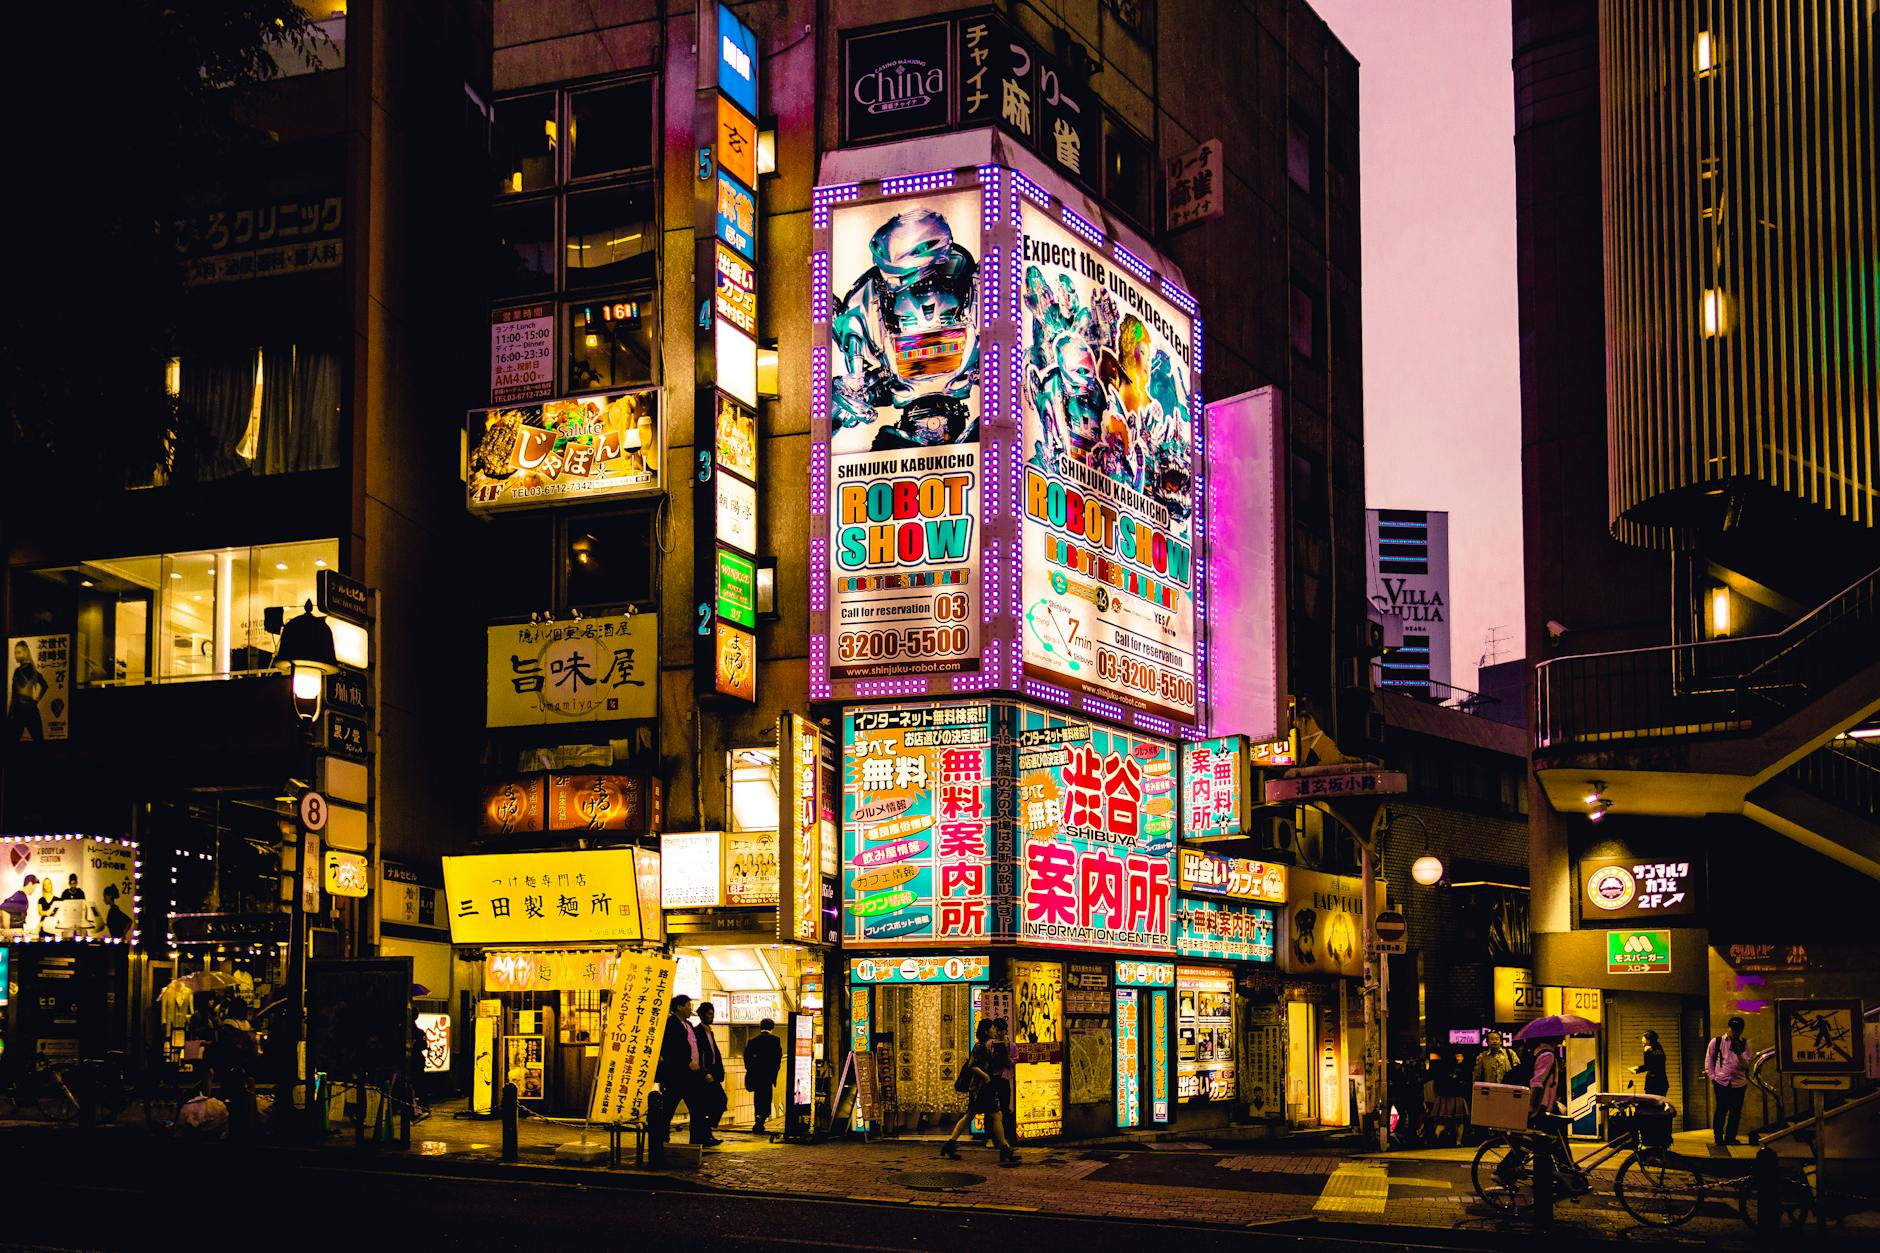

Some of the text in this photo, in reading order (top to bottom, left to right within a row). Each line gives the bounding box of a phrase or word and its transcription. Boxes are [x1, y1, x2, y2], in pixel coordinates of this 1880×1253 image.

[966, 24, 989, 114] チャイナ
[854, 65, 943, 105] China
[699, 148, 711, 180] 5
[725, 224, 746, 250] 5F
[718, 252, 753, 290] 出会い
[722, 277, 753, 312] カフェ
[1023, 235, 1190, 368] Expect the unexpected
[502, 307, 542, 321] 営業時間
[699, 299, 711, 330] 4
[496, 322, 536, 333] ランチ Lunch
[496, 328, 550, 345] 11:00-15:00
[496, 347, 550, 363] 16:00-23:30
[495, 371, 536, 386] AM4:00
[557, 422, 603, 438] Salute
[517, 430, 620, 479] じゃぽん
[699, 449, 712, 482] 3
[838, 453, 974, 478] SHINJUKU KABUKICHO
[473, 484, 503, 503] 4F
[842, 476, 969, 525] ROBOT
[1061, 457, 1168, 527] SHINJUKU KABUKICHO
[1027, 472, 1189, 585] ROBOT SHOW
[841, 519, 968, 567] SHOW
[839, 569, 969, 593] ROBOT RESTAURANT
[1046, 532, 1178, 613] ROBOT RESTAURANT
[1381, 578, 1444, 606] VILLA
[698, 603, 711, 635] 2
[841, 603, 930, 619] Call for reservation
[936, 594, 969, 621] 03
[518, 621, 632, 644] 隠れ個室居酒屋
[840, 627, 967, 659] 3200-5500
[1068, 617, 1092, 652] 7 min
[1114, 630, 1183, 668] Call for reservation
[56, 670, 66, 683] 2F
[511, 649, 645, 694] 旨味屋
[846, 661, 961, 677] www.shinjuku-robot.com
[1098, 650, 1193, 705] 03-3200-5500
[1081, 683, 1147, 711] www.shinjuku-robot.com
[855, 710, 987, 730] インターネット無料検索!!
[854, 739, 898, 757] すべて
[904, 728, 987, 747] お店選びの決定版!!
[556, 777, 571, 787] 2F
[862, 755, 928, 791] 無料
[1295, 775, 1377, 796] 道玄坂小路
[1021, 782, 1045, 801] すべて
[1062, 743, 1142, 838] 渋谷
[1191, 748, 1211, 832] 案内所
[1213, 762, 1231, 813] 無料
[308, 799, 321, 825] 8
[854, 800, 908, 822] グルメ情報
[1027, 797, 1062, 831] 無料
[939, 747, 987, 938] 無料案内所
[1066, 826, 1137, 848] SHIBUYA
[861, 839, 920, 865] 飲み屋情報
[491, 873, 588, 889] つけ麺専門店
[856, 865, 915, 889] カフェ情報
[1183, 853, 1227, 885] 出会い
[1248, 864, 1260, 874] 6F
[1632, 862, 1689, 879] サンマルク
[122, 881, 132, 895] 2F
[1026, 842, 1171, 935] 案内所
[1226, 871, 1262, 896] カフェ
[457, 892, 612, 920] 三田製麺所
[853, 890, 914, 916] タウン情報
[1638, 894, 1663, 909] 2F
[865, 914, 930, 937] プレイスポット情報
[1024, 922, 1169, 946] INFORMATION CENTER
[1193, 908, 1256, 940] 無料案内所
[873, 959, 896, 968] トイレ
[917, 958, 939, 967] タバコ
[963, 957, 983, 967] 充電
[1614, 953, 1665, 963] モスバーガー
[1515, 987, 1544, 1008] 209
[1575, 992, 1598, 1009] 209
[1177, 1075, 1211, 1098] 出会い
[1210, 1080, 1235, 1099] カフェ
